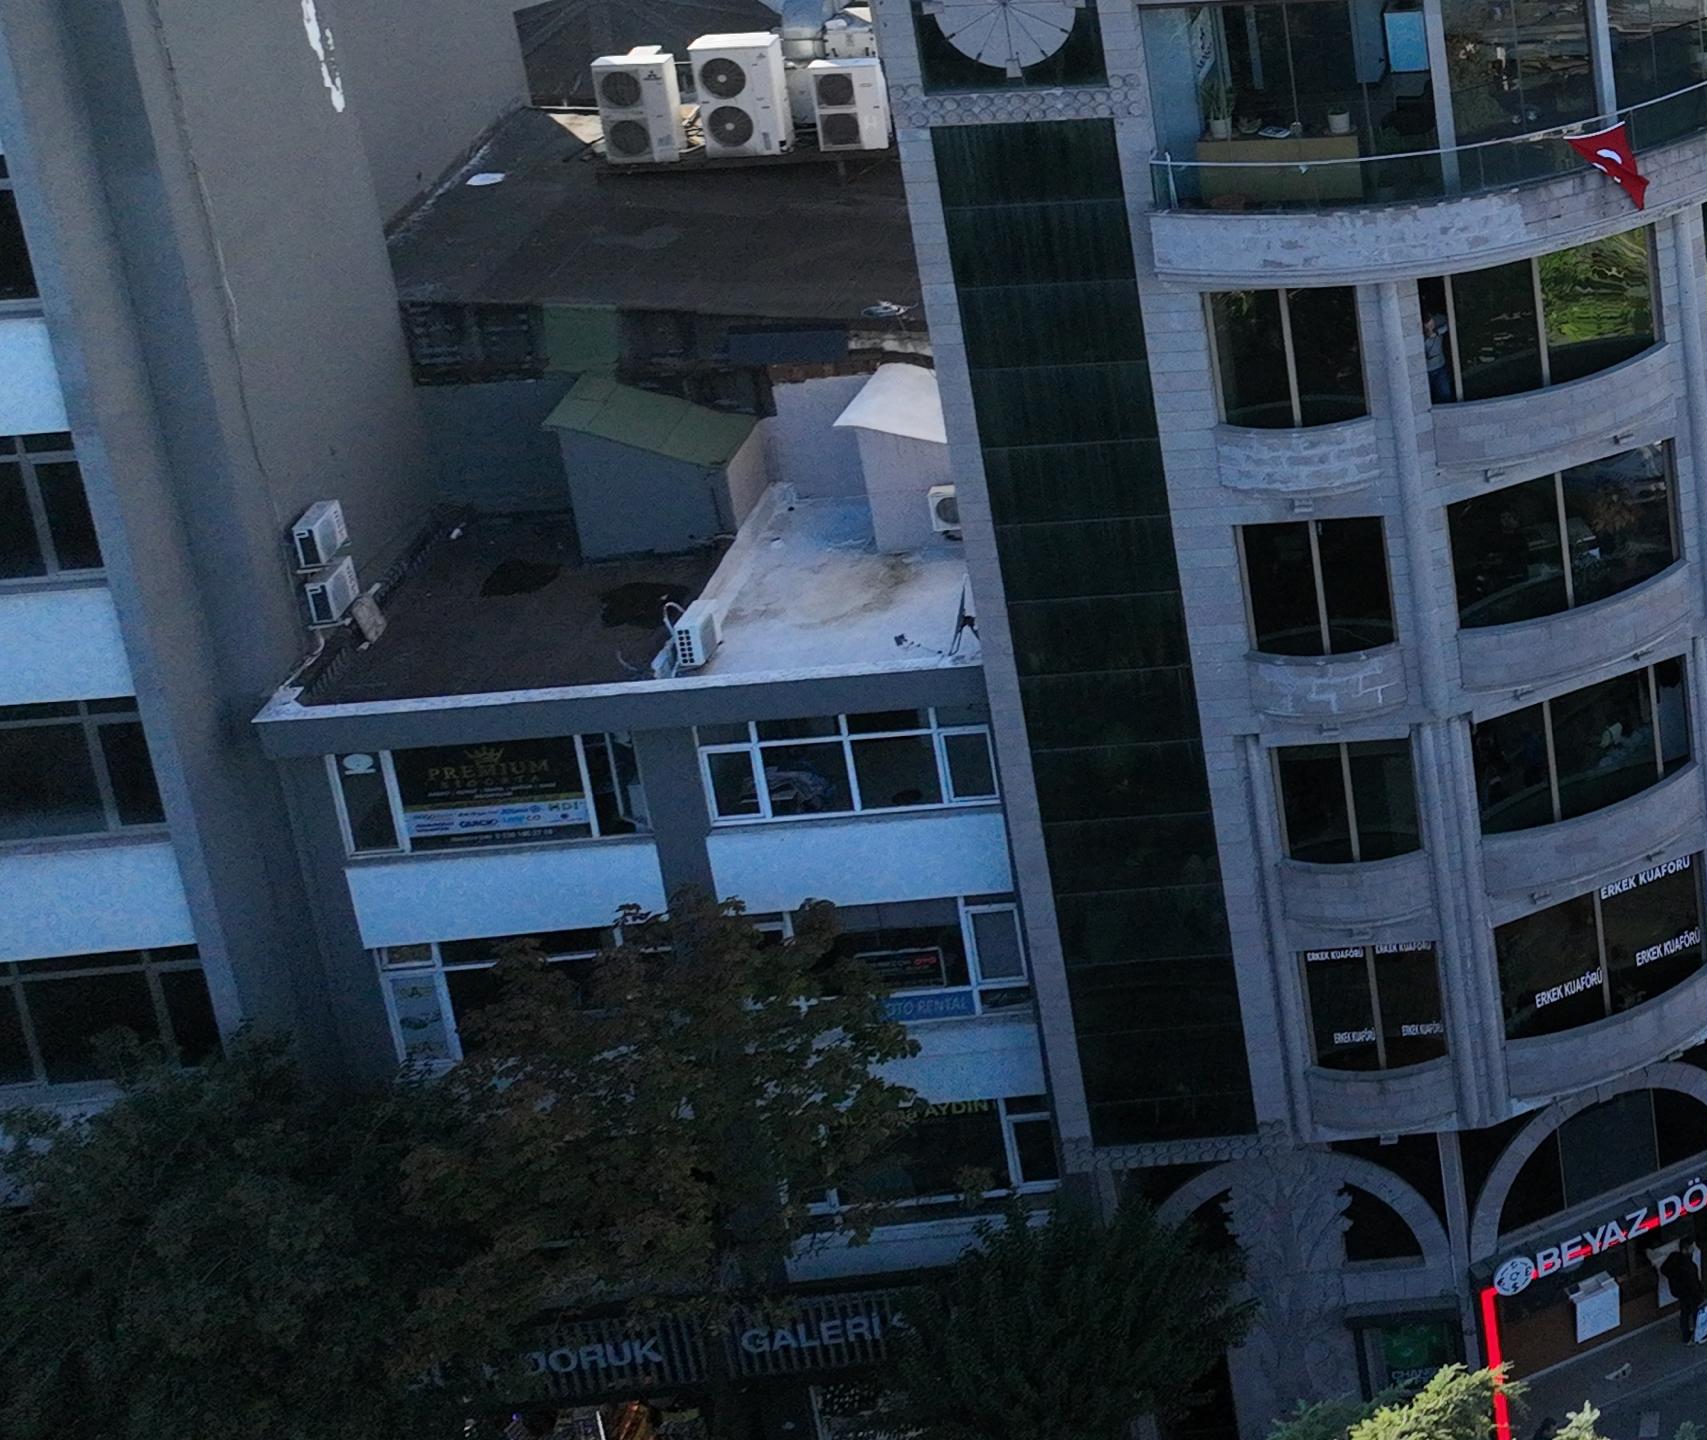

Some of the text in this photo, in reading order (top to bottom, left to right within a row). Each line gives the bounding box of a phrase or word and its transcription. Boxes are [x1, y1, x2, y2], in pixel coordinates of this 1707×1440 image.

[427, 759, 551, 781] PREMIUM
[1600, 876, 1638, 901] ERKEK
[1635, 943, 1664, 968] ERKEK
[917, 995, 969, 1014] RENTAL
[1535, 986, 1565, 1009] ERKEK
[1535, 1206, 1650, 1279] BEYAZ
